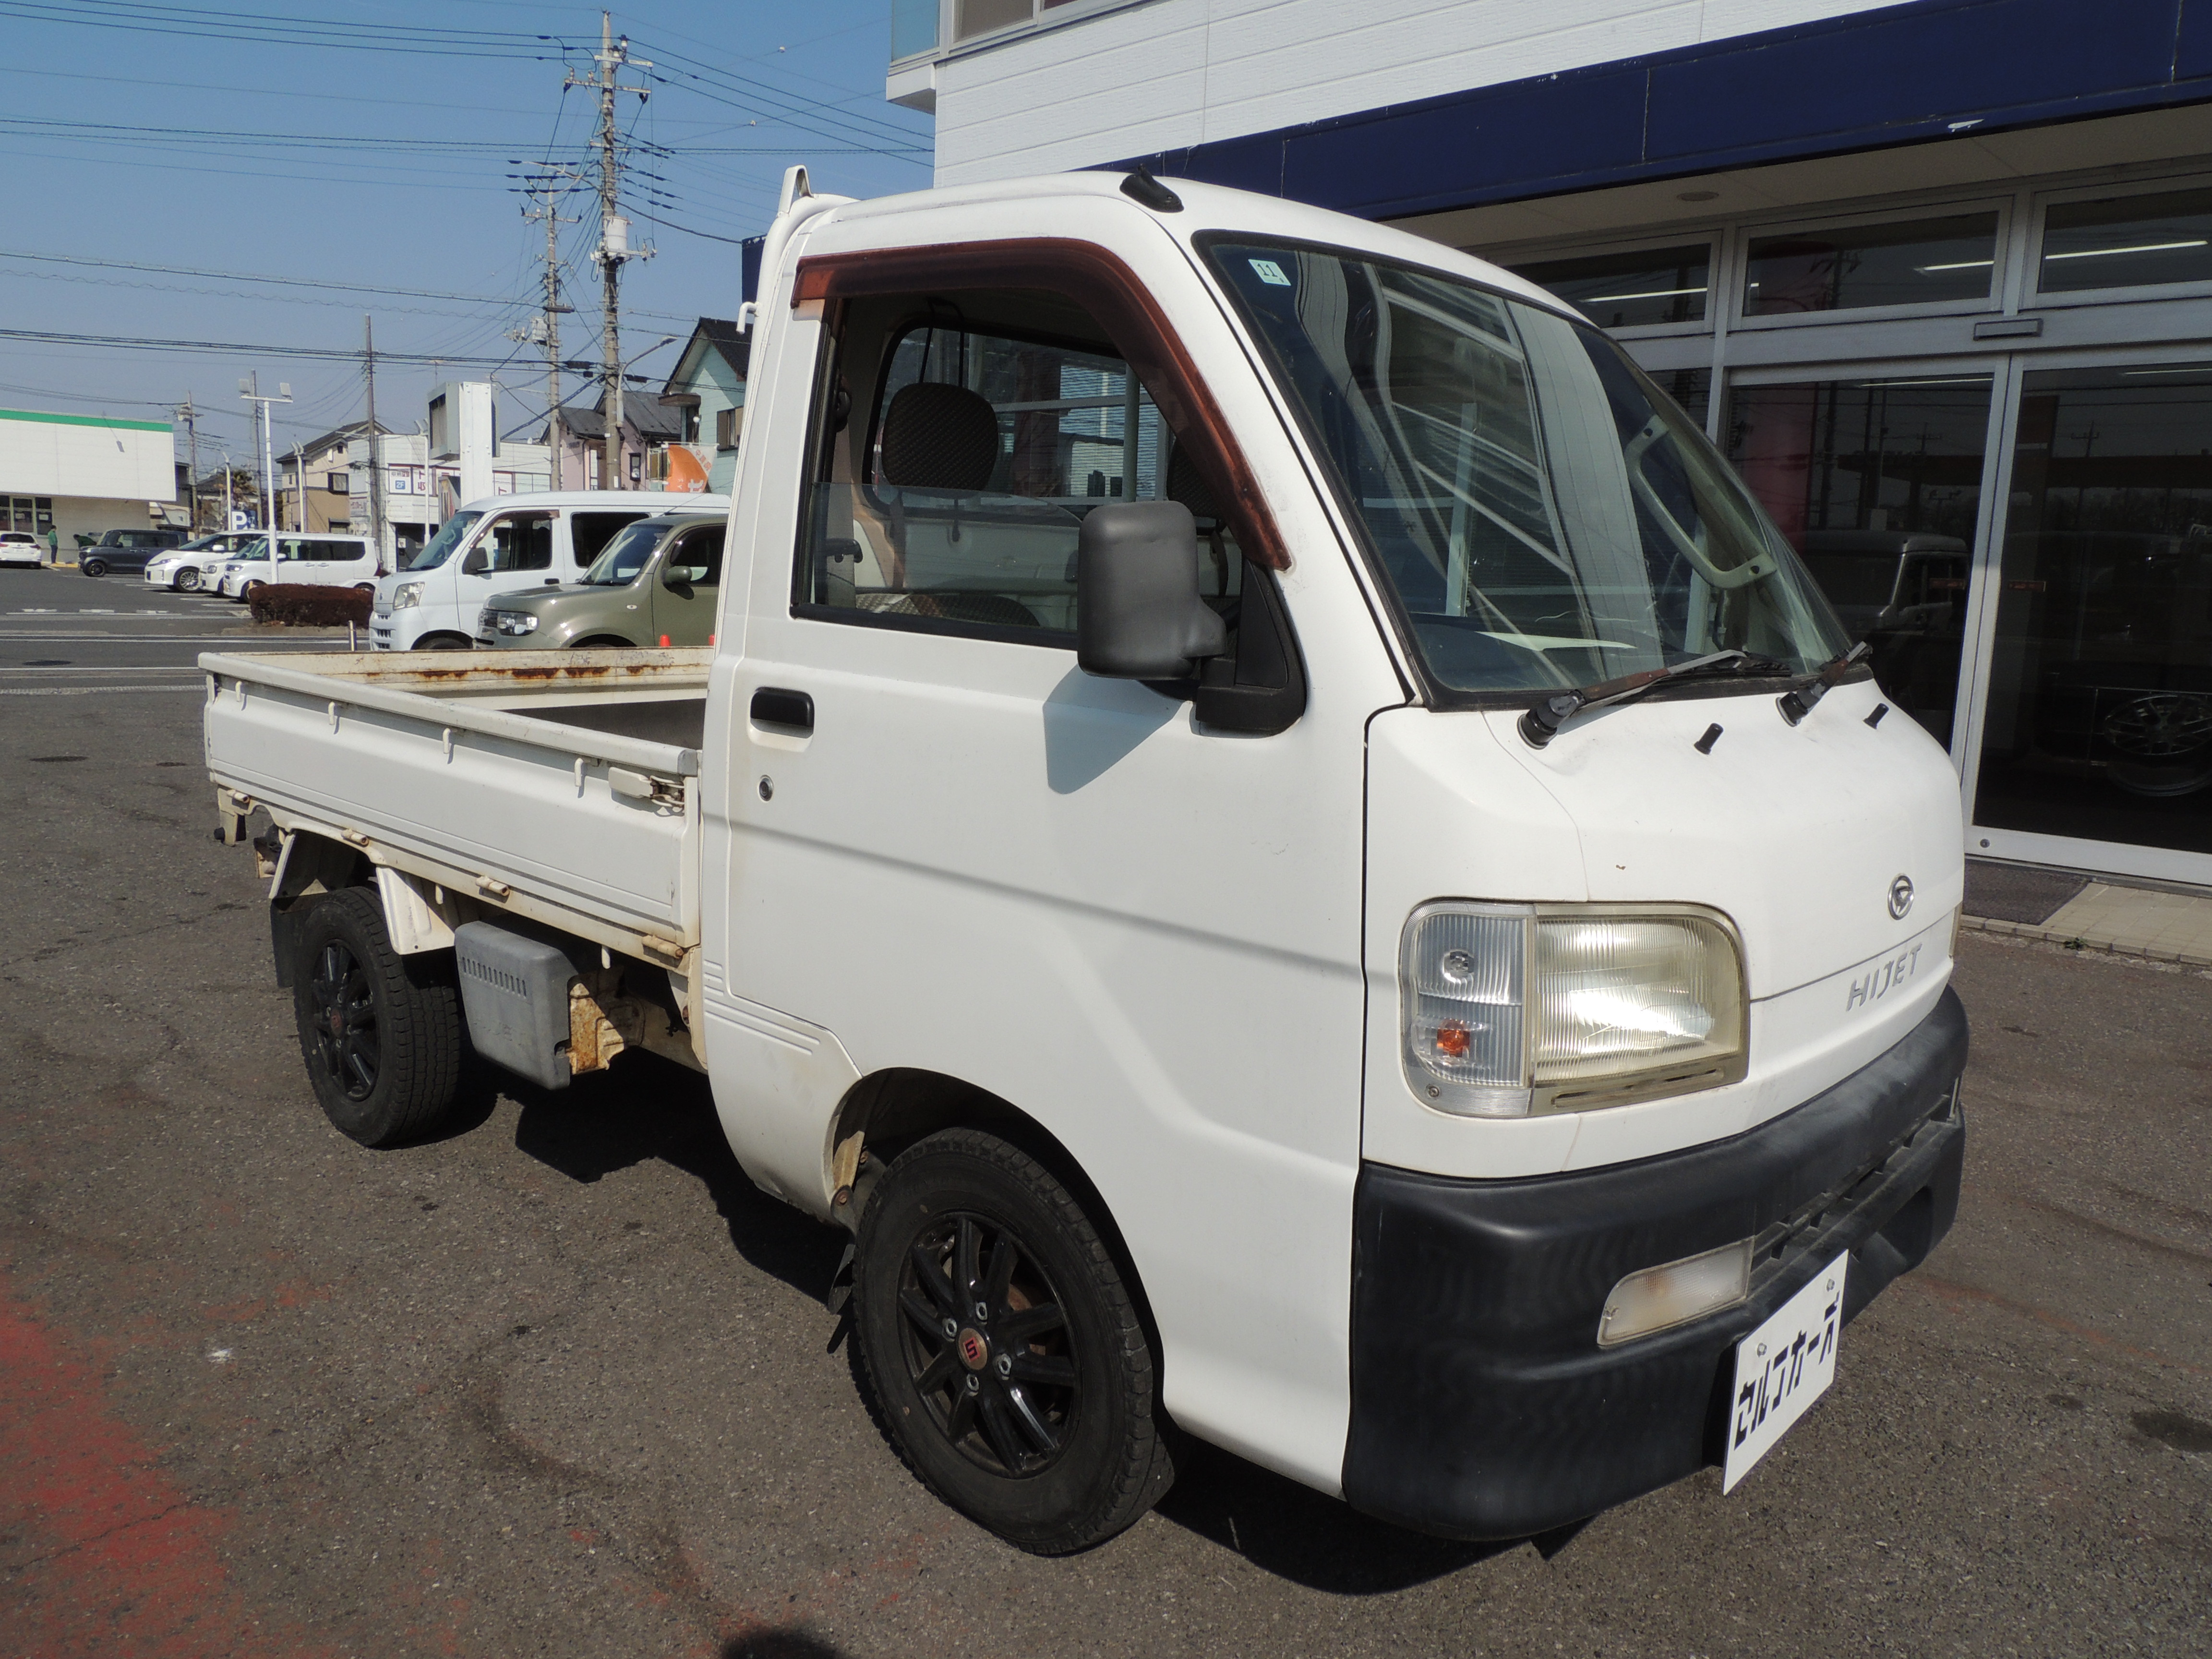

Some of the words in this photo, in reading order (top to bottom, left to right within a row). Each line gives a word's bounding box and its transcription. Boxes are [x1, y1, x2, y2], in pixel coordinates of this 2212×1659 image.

[1257, 264, 1278, 277] 11
[232, 511, 247, 530] P
[1846, 943, 1923, 1011] HIJET
